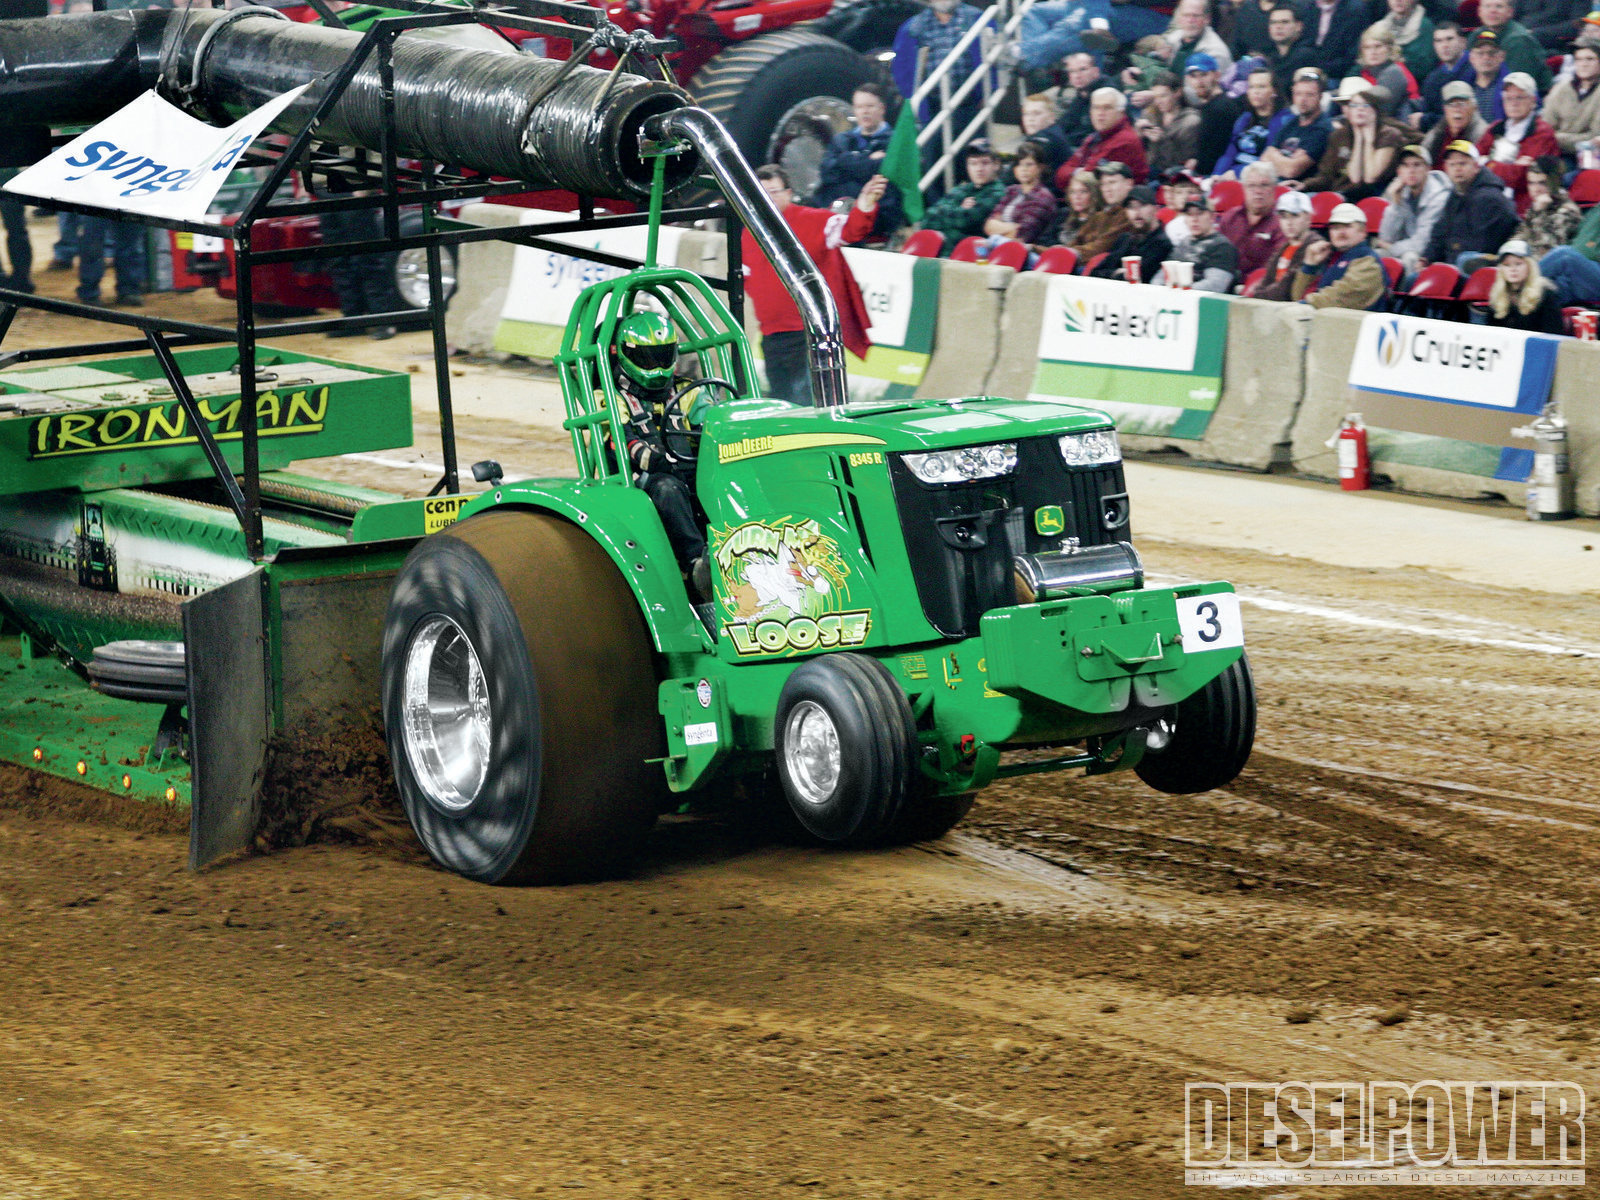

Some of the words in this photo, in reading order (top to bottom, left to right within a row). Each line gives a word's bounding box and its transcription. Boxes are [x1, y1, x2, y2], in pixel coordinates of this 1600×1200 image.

[64, 134, 253, 197] syngea
[1411, 330, 1501, 372] Cruiser
[36, 386, 329, 451] IRONMAN
[718, 442, 743, 459] JOHN
[742, 435, 775, 454] DEERE
[849, 453, 874, 468] 8345
[426, 499, 468, 514] cen
[717, 523, 781, 574] TURN
[726, 610, 869, 655] LOOSE
[1196, 600, 1222, 643] 3
